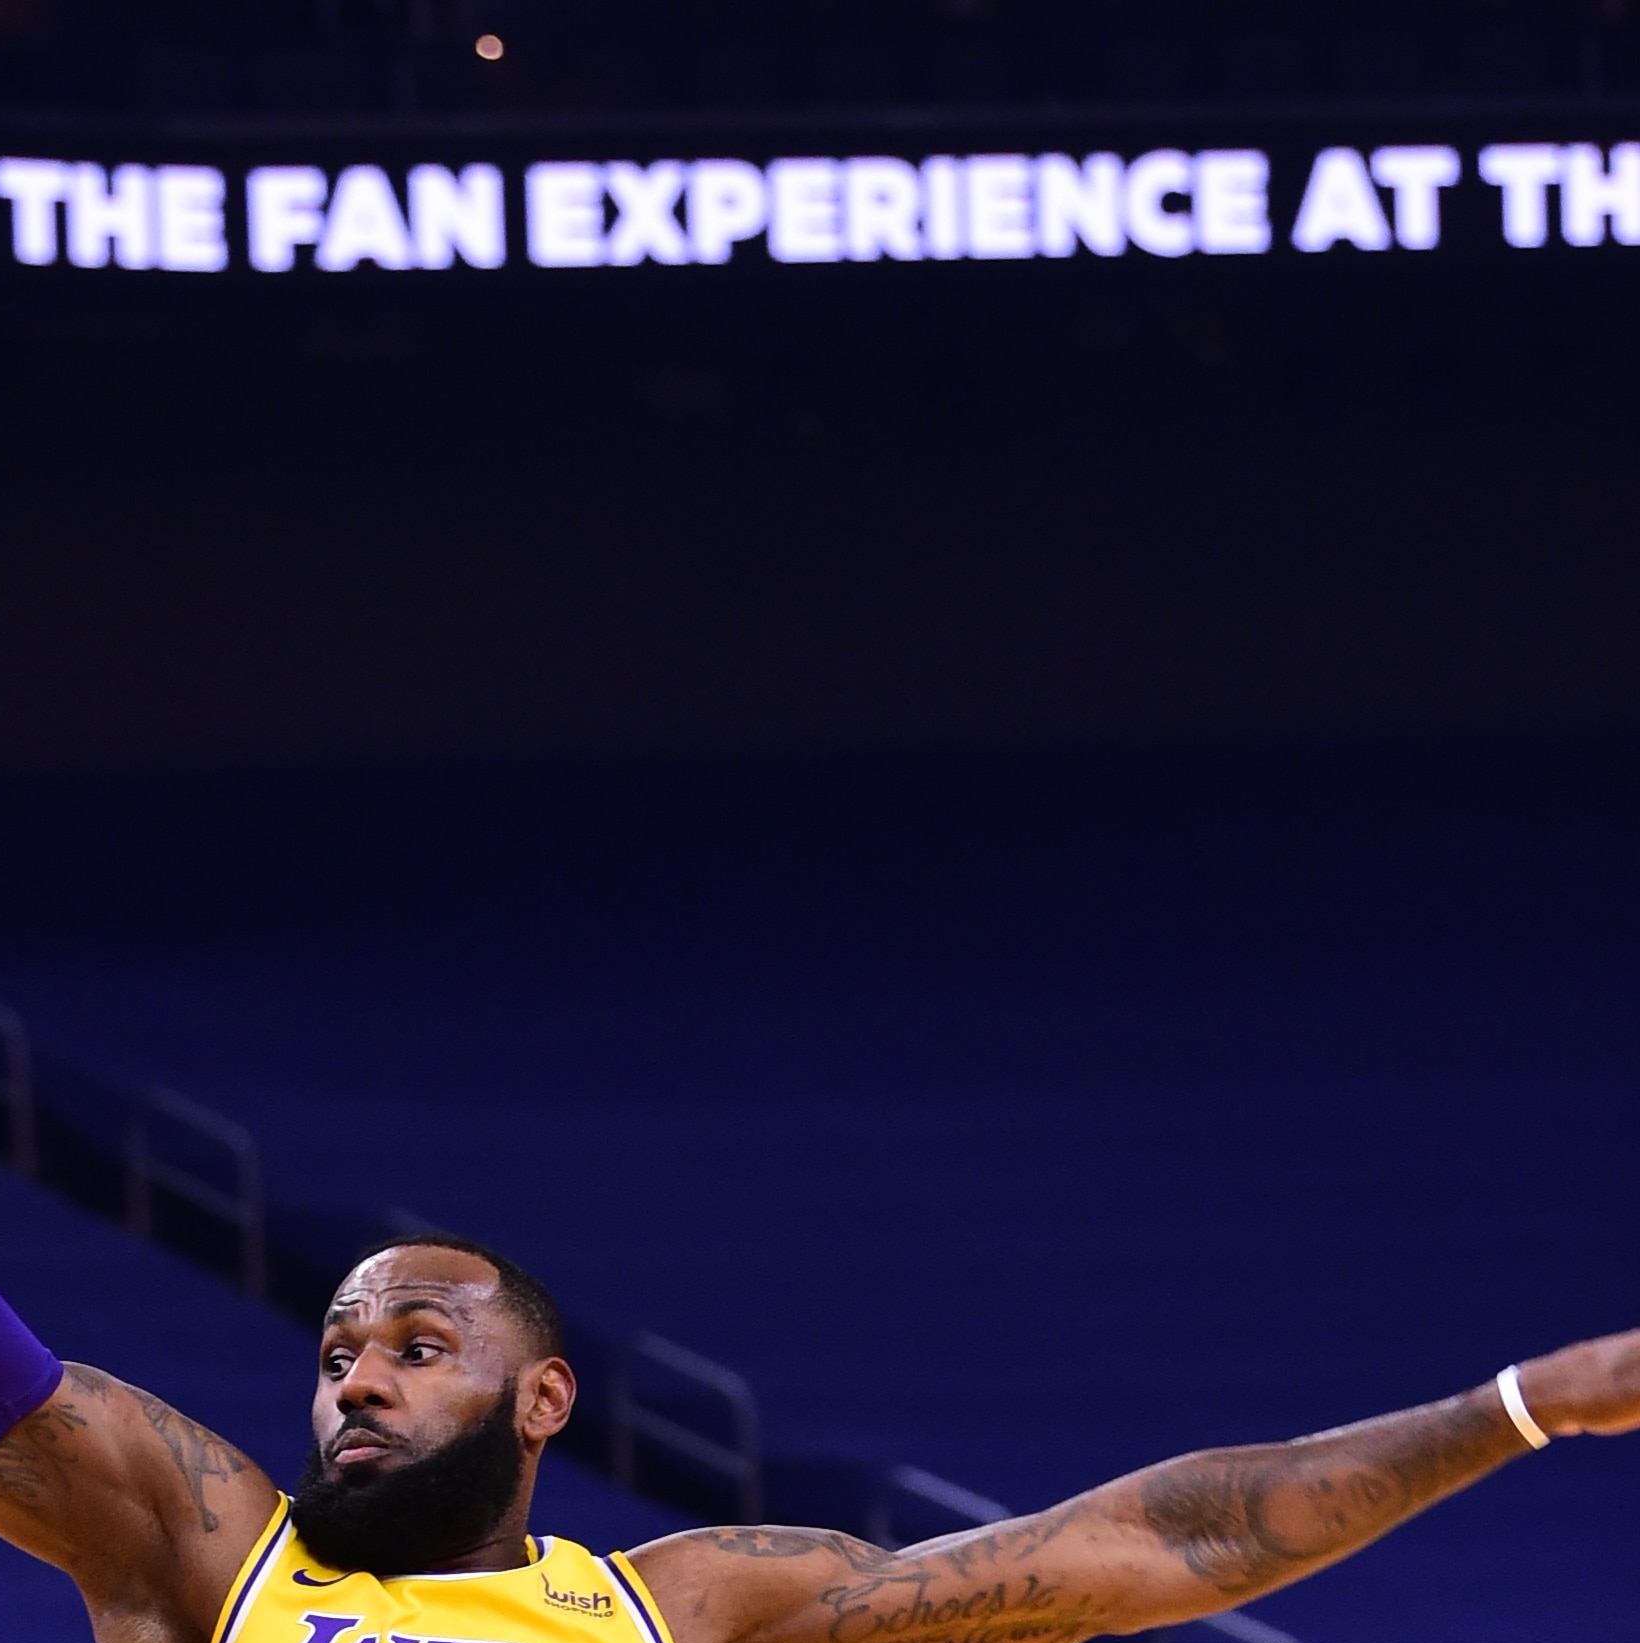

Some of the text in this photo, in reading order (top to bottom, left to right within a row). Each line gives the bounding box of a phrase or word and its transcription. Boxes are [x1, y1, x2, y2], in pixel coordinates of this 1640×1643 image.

[246, 163, 506, 273] FAN
[525, 150, 1271, 268] EXPERIENCE
[1292, 146, 1460, 253] AT
[541, 1572, 611, 1611] wish
